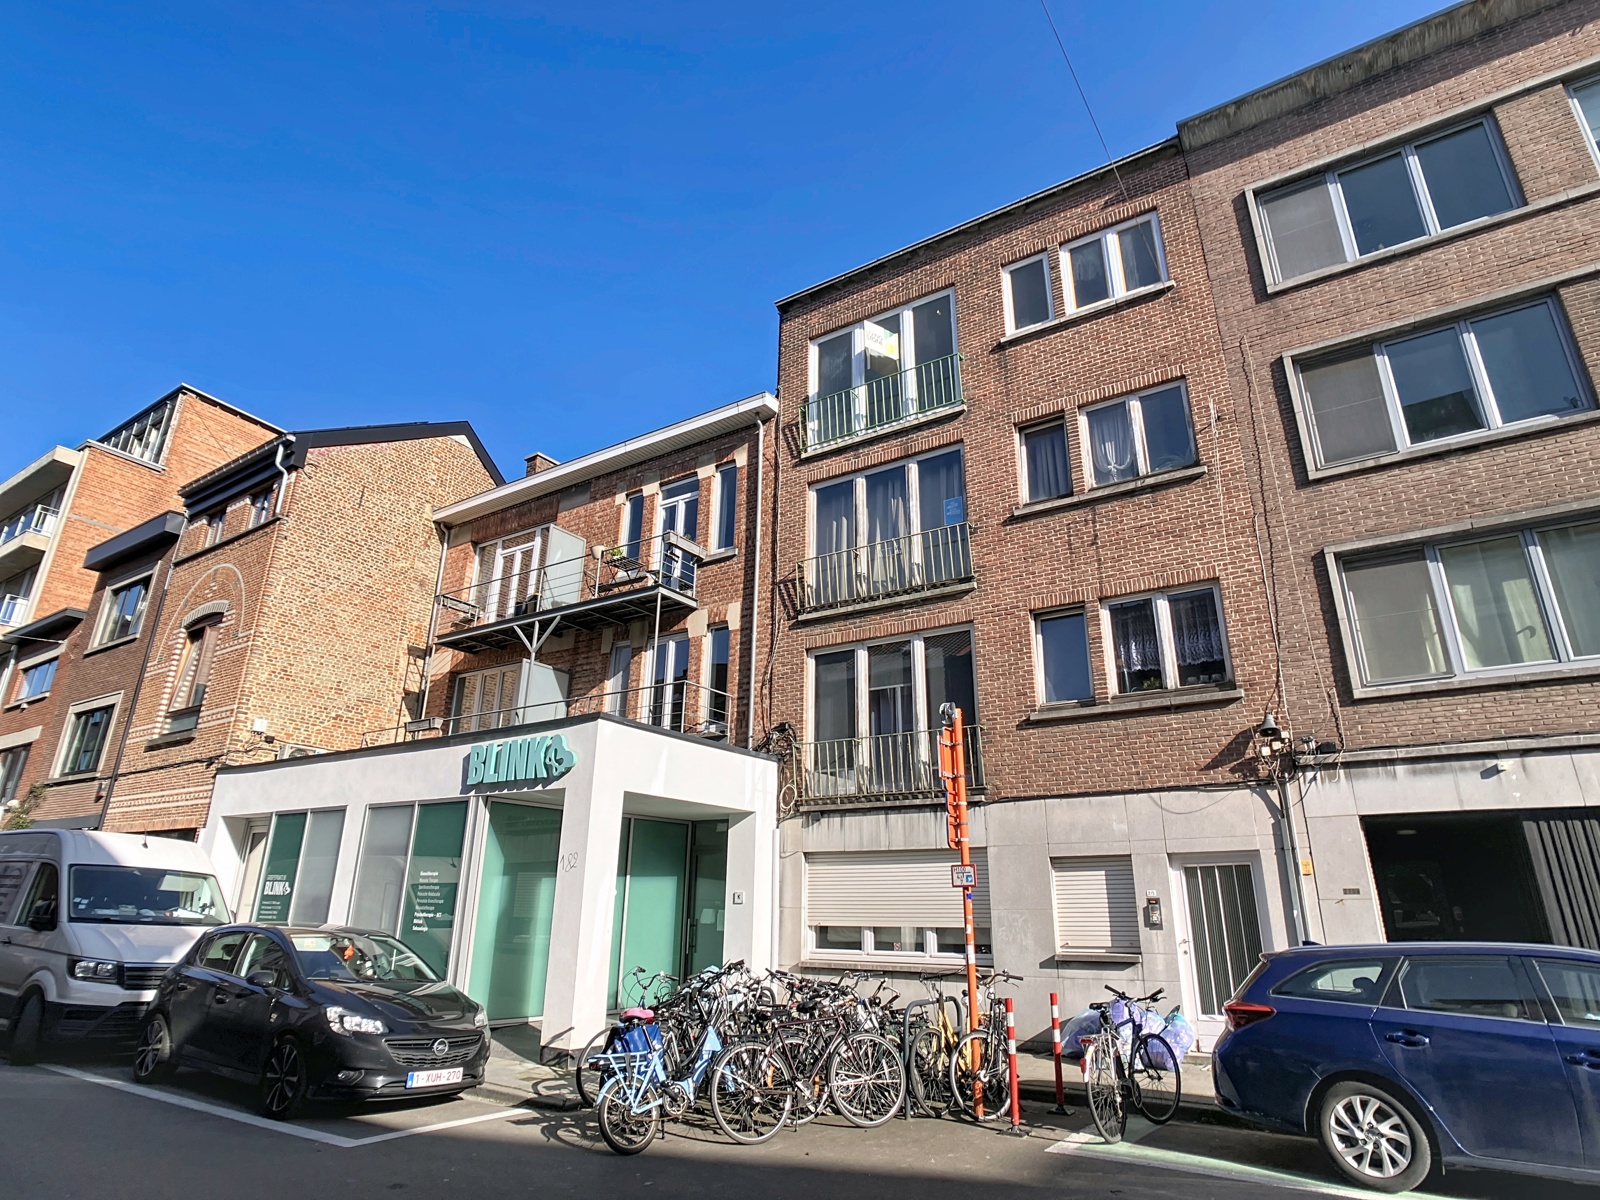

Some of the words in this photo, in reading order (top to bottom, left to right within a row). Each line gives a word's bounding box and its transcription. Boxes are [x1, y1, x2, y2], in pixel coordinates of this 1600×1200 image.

[466, 736, 550, 785] BLINK
[560, 852, 578, 872] 182
[264, 882, 284, 896] BLINK
[415, 1070, 461, 1084] 1-XUH-270
